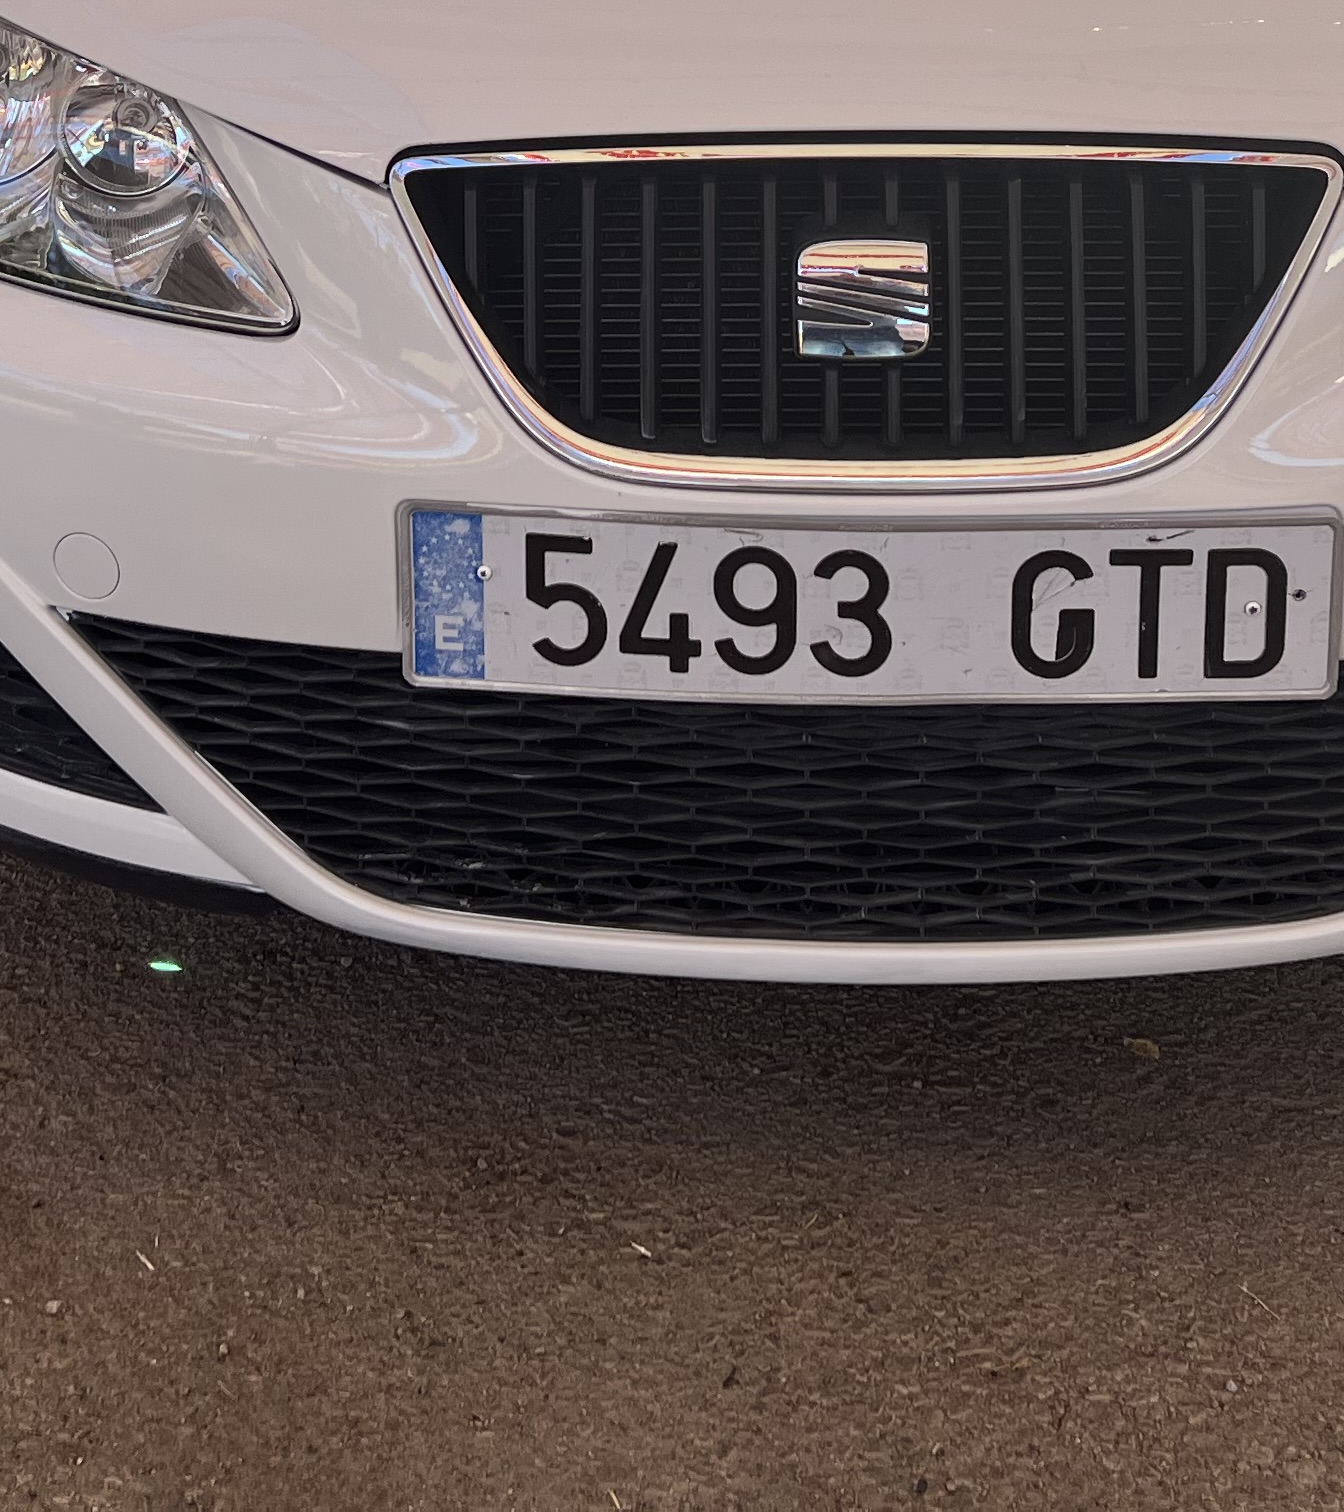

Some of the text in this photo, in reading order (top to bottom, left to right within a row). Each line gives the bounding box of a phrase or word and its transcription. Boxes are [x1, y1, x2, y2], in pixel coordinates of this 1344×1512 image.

[434, 614, 464, 651] E
[524, 533, 1288, 680] 5493 GTD
